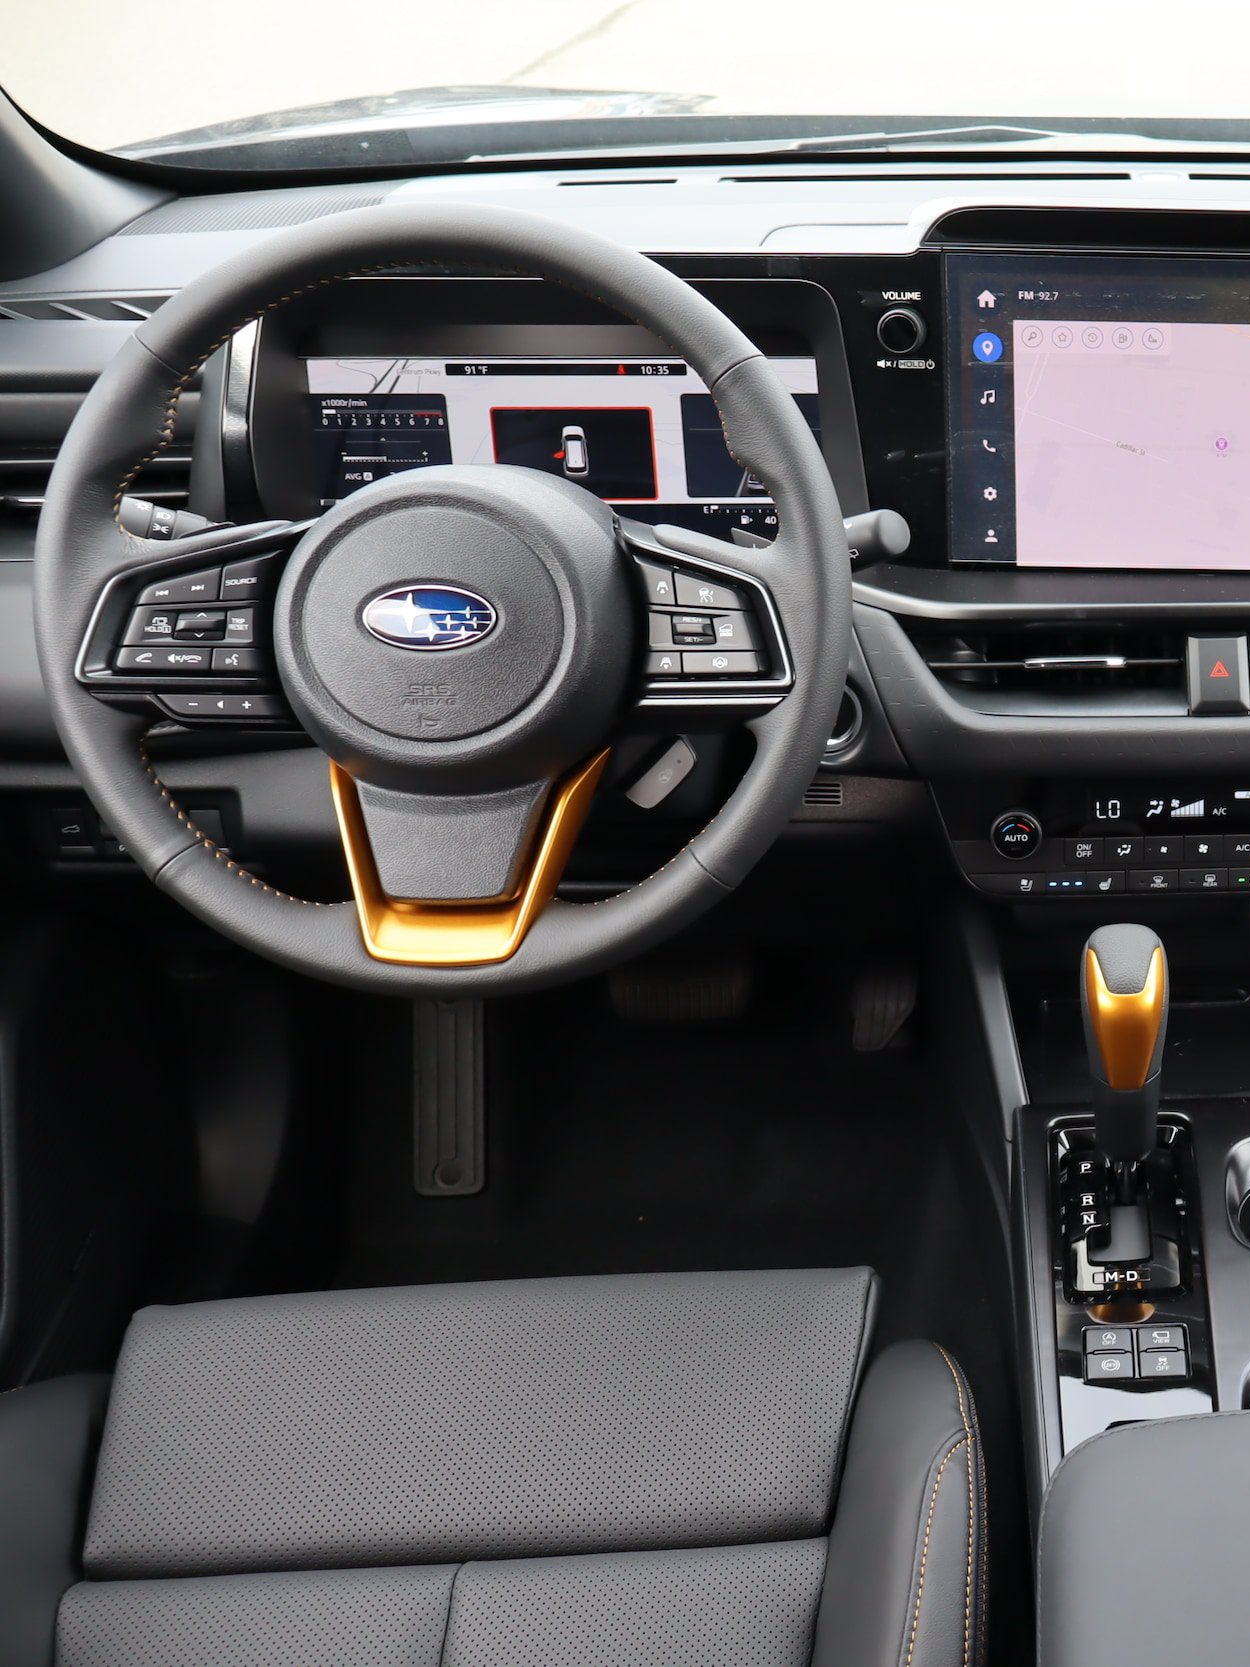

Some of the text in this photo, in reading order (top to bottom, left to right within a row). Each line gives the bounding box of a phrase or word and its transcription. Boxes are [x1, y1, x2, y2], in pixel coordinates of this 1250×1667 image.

[882, 291, 921, 300] VOLUME
[1018, 290, 1059, 300] FM 92.7
[900, 360, 925, 368] HOLD
[464, 366, 475, 374] 91
[640, 366, 670, 375] 10:35
[322, 398, 368, 407] x1000r/min
[322, 418, 444, 426] 0 1 2 3 4 5 6 7 8
[344, 472, 362, 480] AVG
[703, 506, 709, 514] E
[764, 516, 777, 525] 40
[225, 577, 258, 586] SOURCE
[409, 684, 451, 695] SRS
[402, 698, 457, 706] AIRBAG
[1096, 800, 1121, 819] LO
[1212, 808, 1227, 816] A/C
[1004, 834, 1028, 842] AUTO
[1081, 1164, 1091, 1173] P
[1082, 1195, 1094, 1206] R
[1083, 1214, 1096, 1225] N
